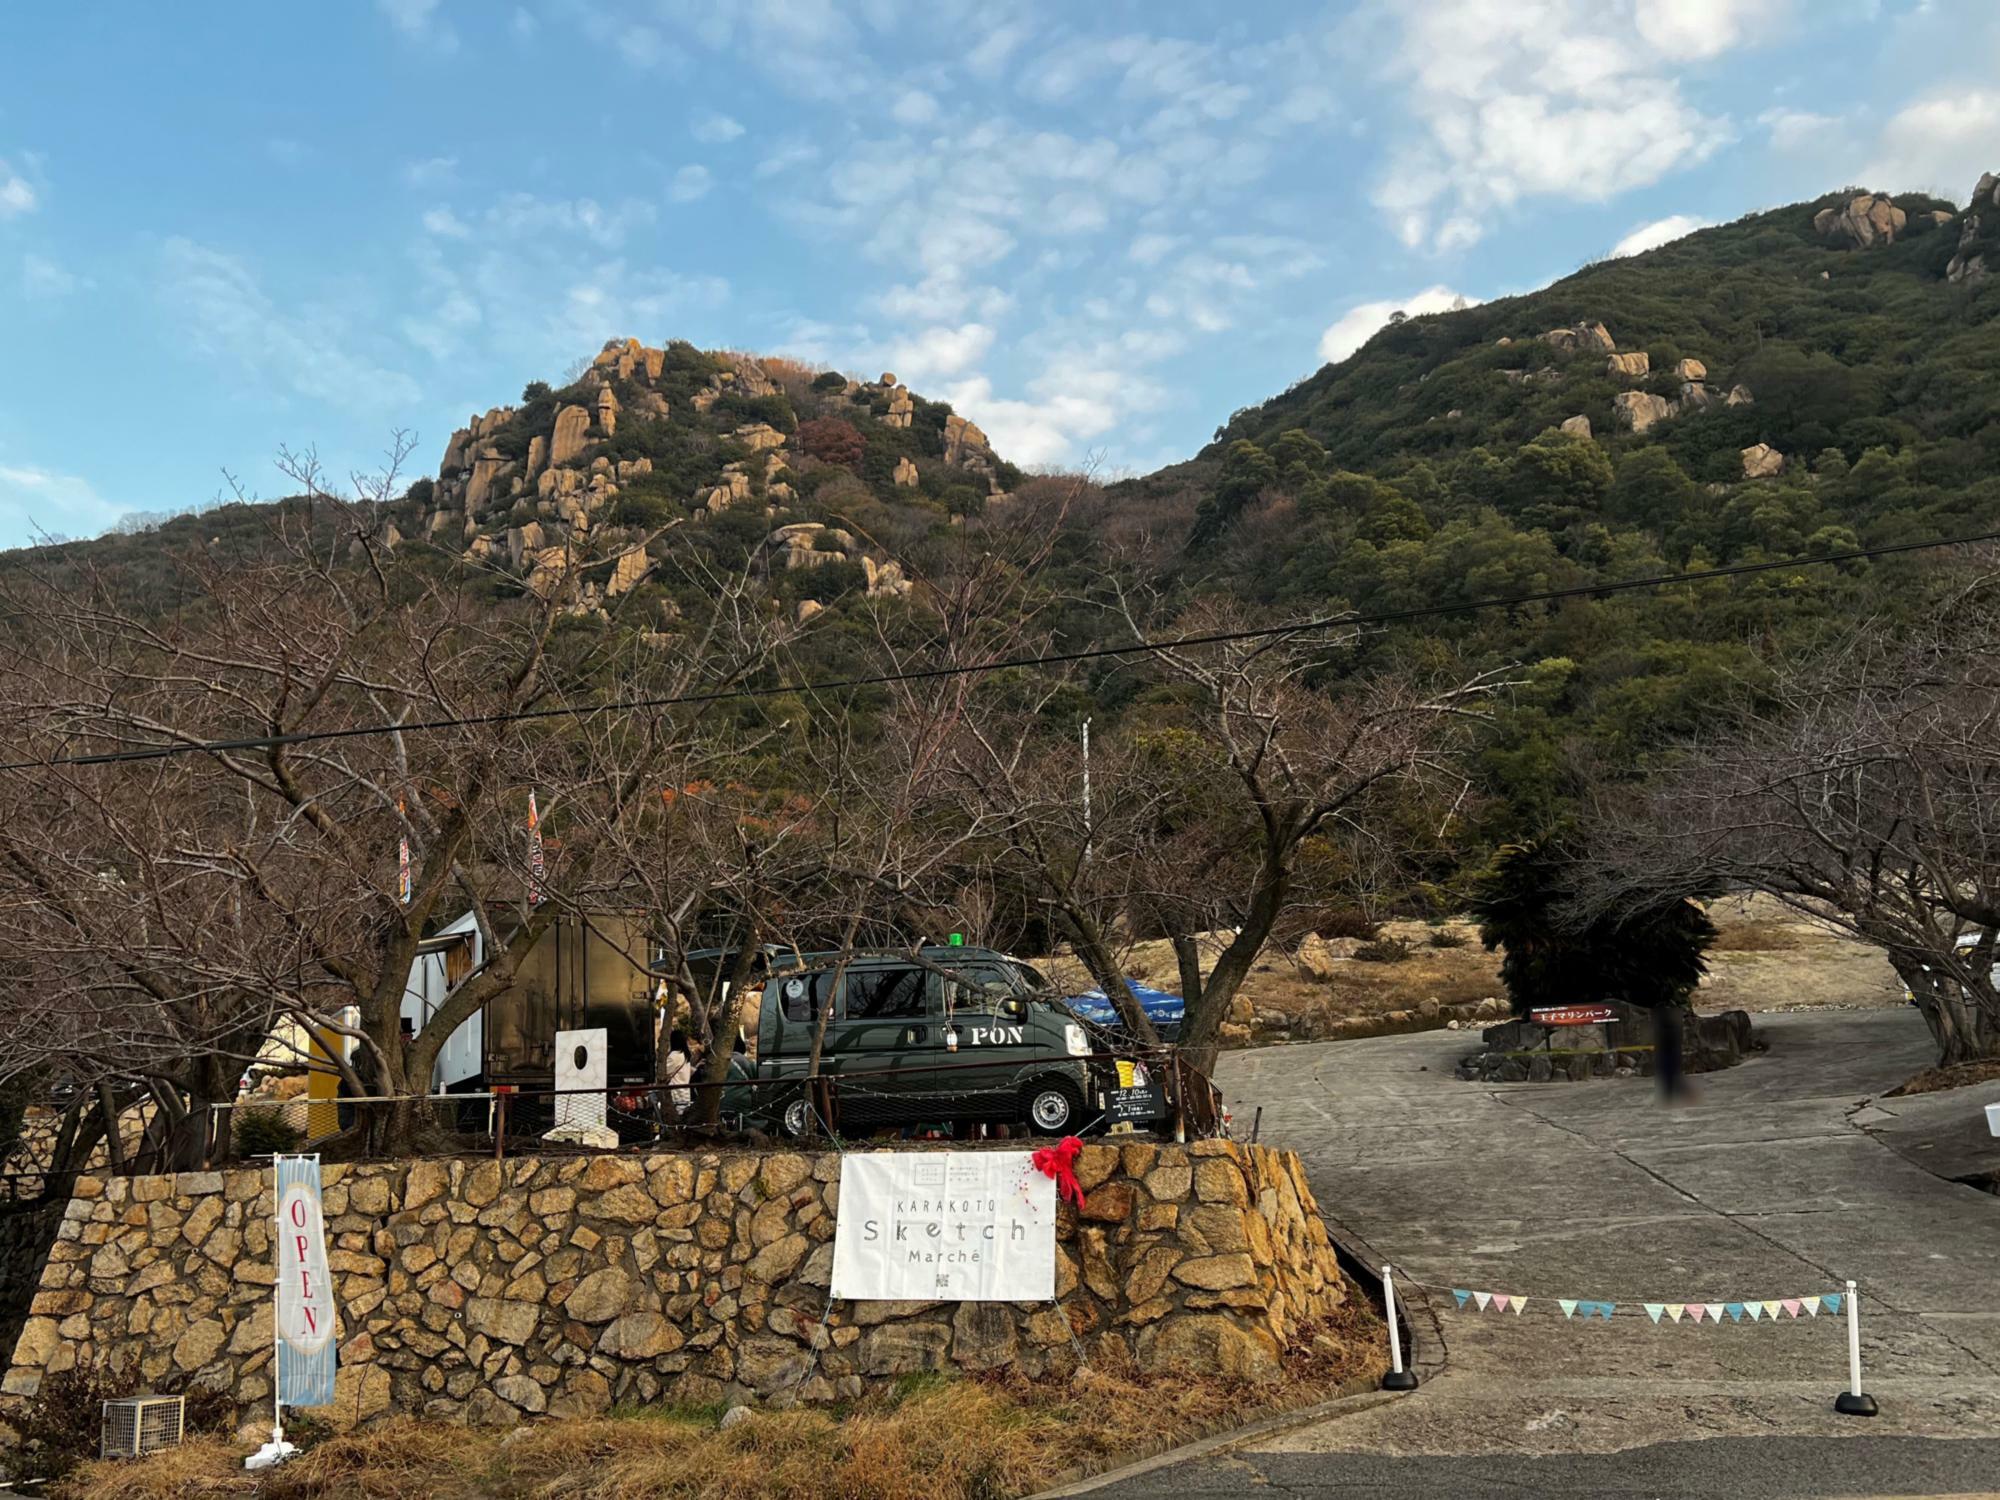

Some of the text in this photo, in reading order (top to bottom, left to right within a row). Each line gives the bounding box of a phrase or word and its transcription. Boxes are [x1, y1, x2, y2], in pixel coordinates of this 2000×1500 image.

[971, 1027, 1024, 1045] PON
[897, 1200, 995, 1213] KARAKOTO
[863, 1218, 1026, 1241] Sketch
[908, 1249, 980, 1263] Marché
[291, 1199, 317, 1335] OPEN
